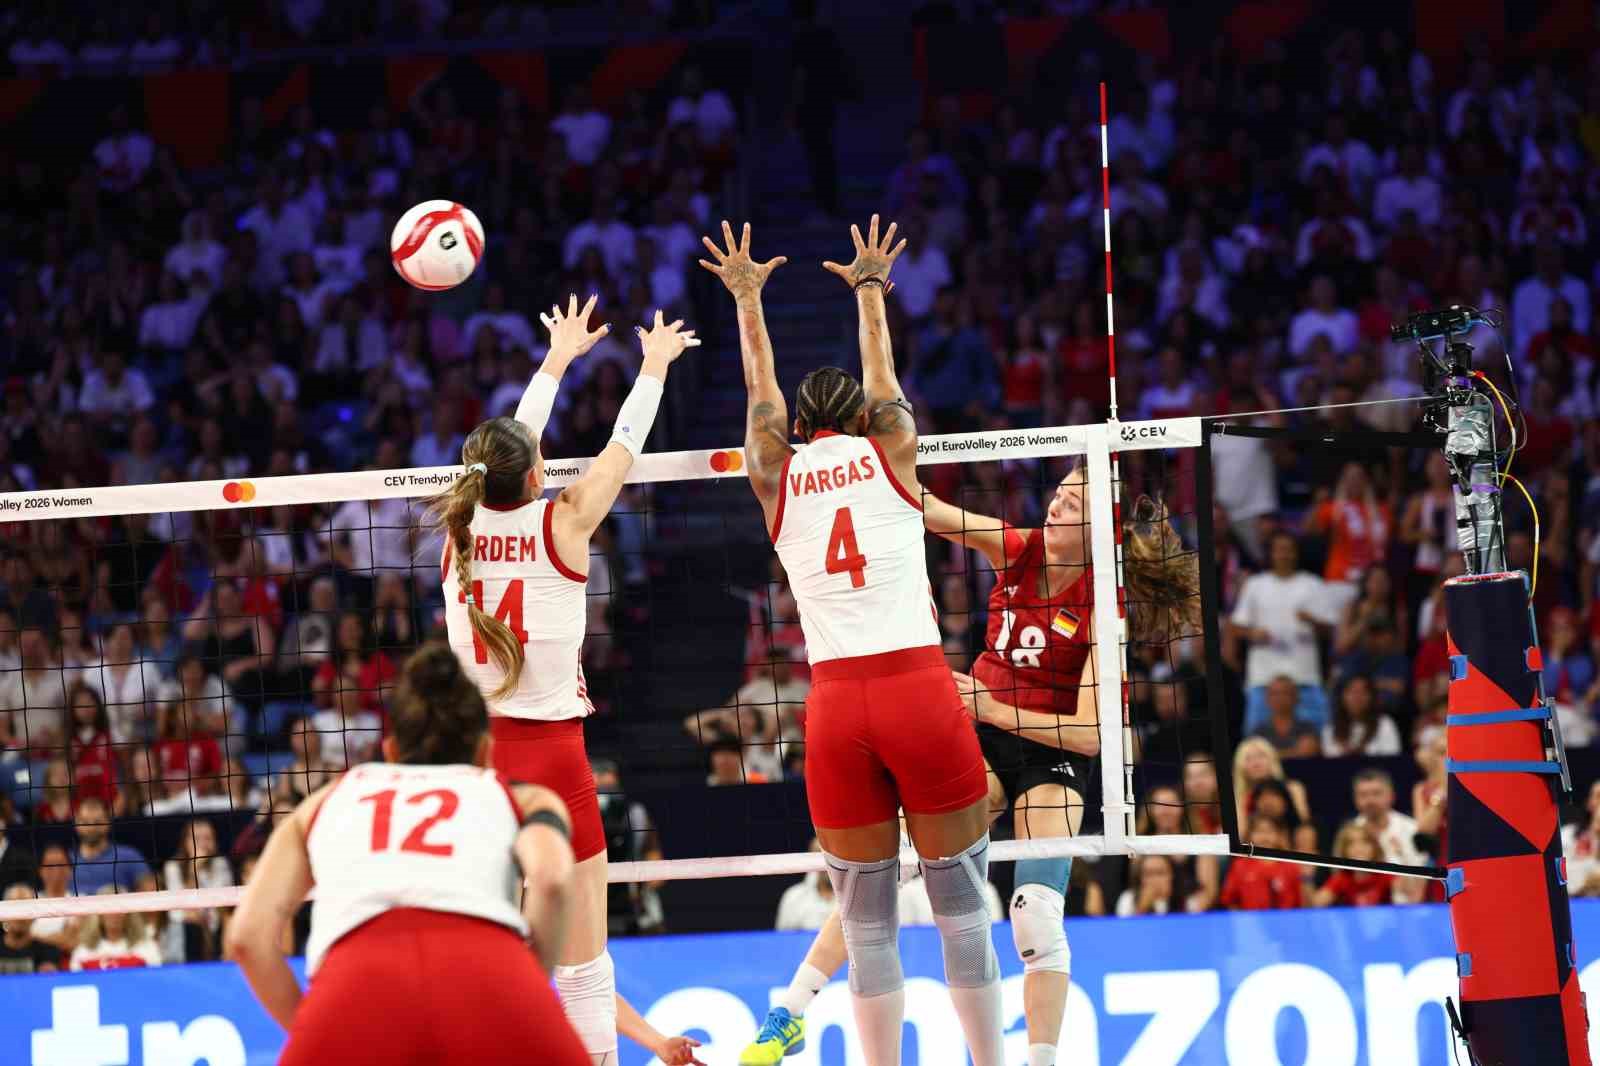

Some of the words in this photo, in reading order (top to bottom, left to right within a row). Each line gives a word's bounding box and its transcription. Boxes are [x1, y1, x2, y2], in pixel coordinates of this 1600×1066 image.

[942, 438, 998, 452] EuroVolley
[1000, 436, 1025, 448] 2026
[1027, 434, 1068, 445] Women
[1140, 426, 1167, 438] CEV
[384, 474, 406, 486] CEV
[408, 472, 453, 486] Trendyol
[790, 455, 875, 497] VARGAS
[24, 498, 50, 509] 2026
[52, 496, 93, 507] Women
[474, 535, 537, 563] RDEM
[825, 506, 867, 589] 4
[458, 579, 529, 665] 14
[994, 608, 1047, 668] 18
[358, 788, 461, 857] 12
